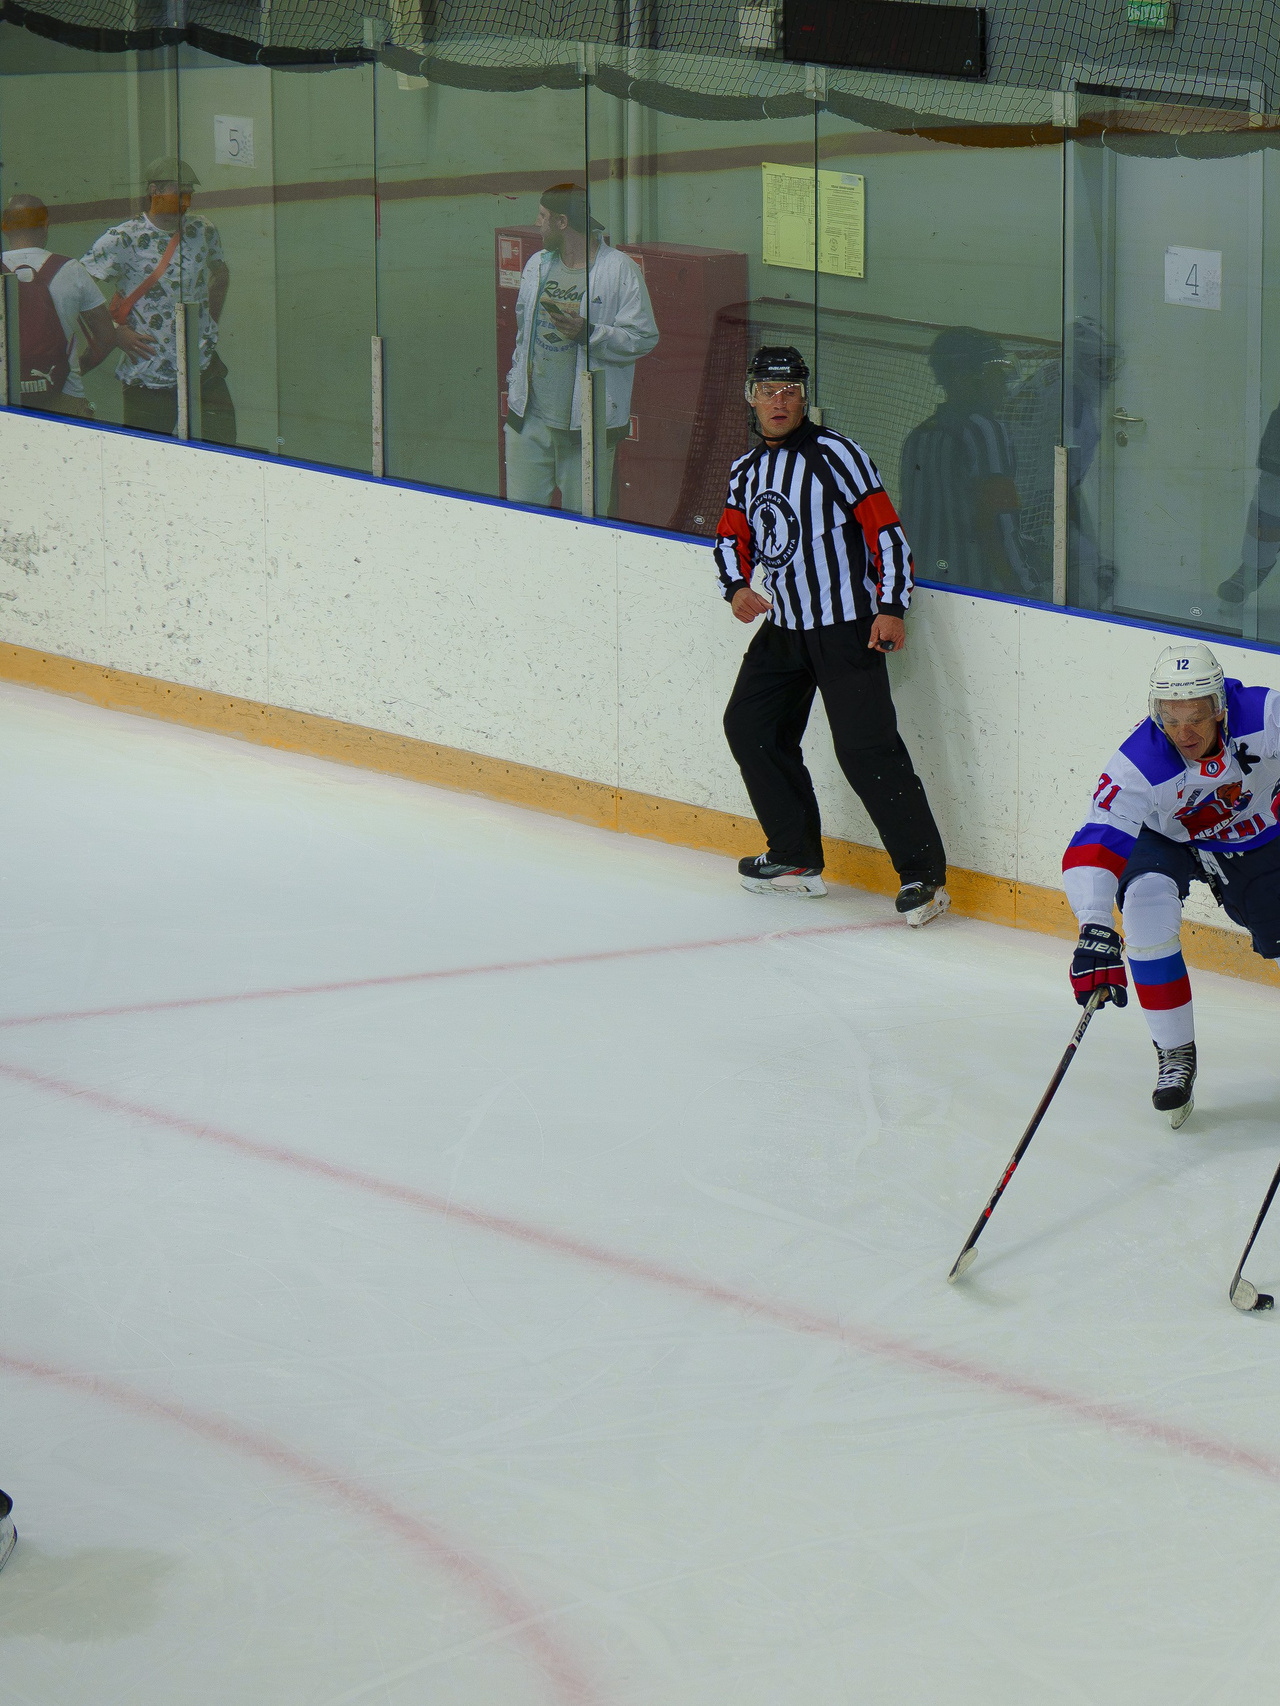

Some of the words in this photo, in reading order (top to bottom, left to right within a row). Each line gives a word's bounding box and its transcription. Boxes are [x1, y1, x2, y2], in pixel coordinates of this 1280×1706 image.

[228, 128, 239, 157] 5
[1185, 263, 1199, 296] 4
[1176, 659, 1190, 671] 12
[1088, 928, 1112, 939] S29
[1079, 939, 1119, 957] AUER
[1075, 1012, 1092, 1044] CCM
